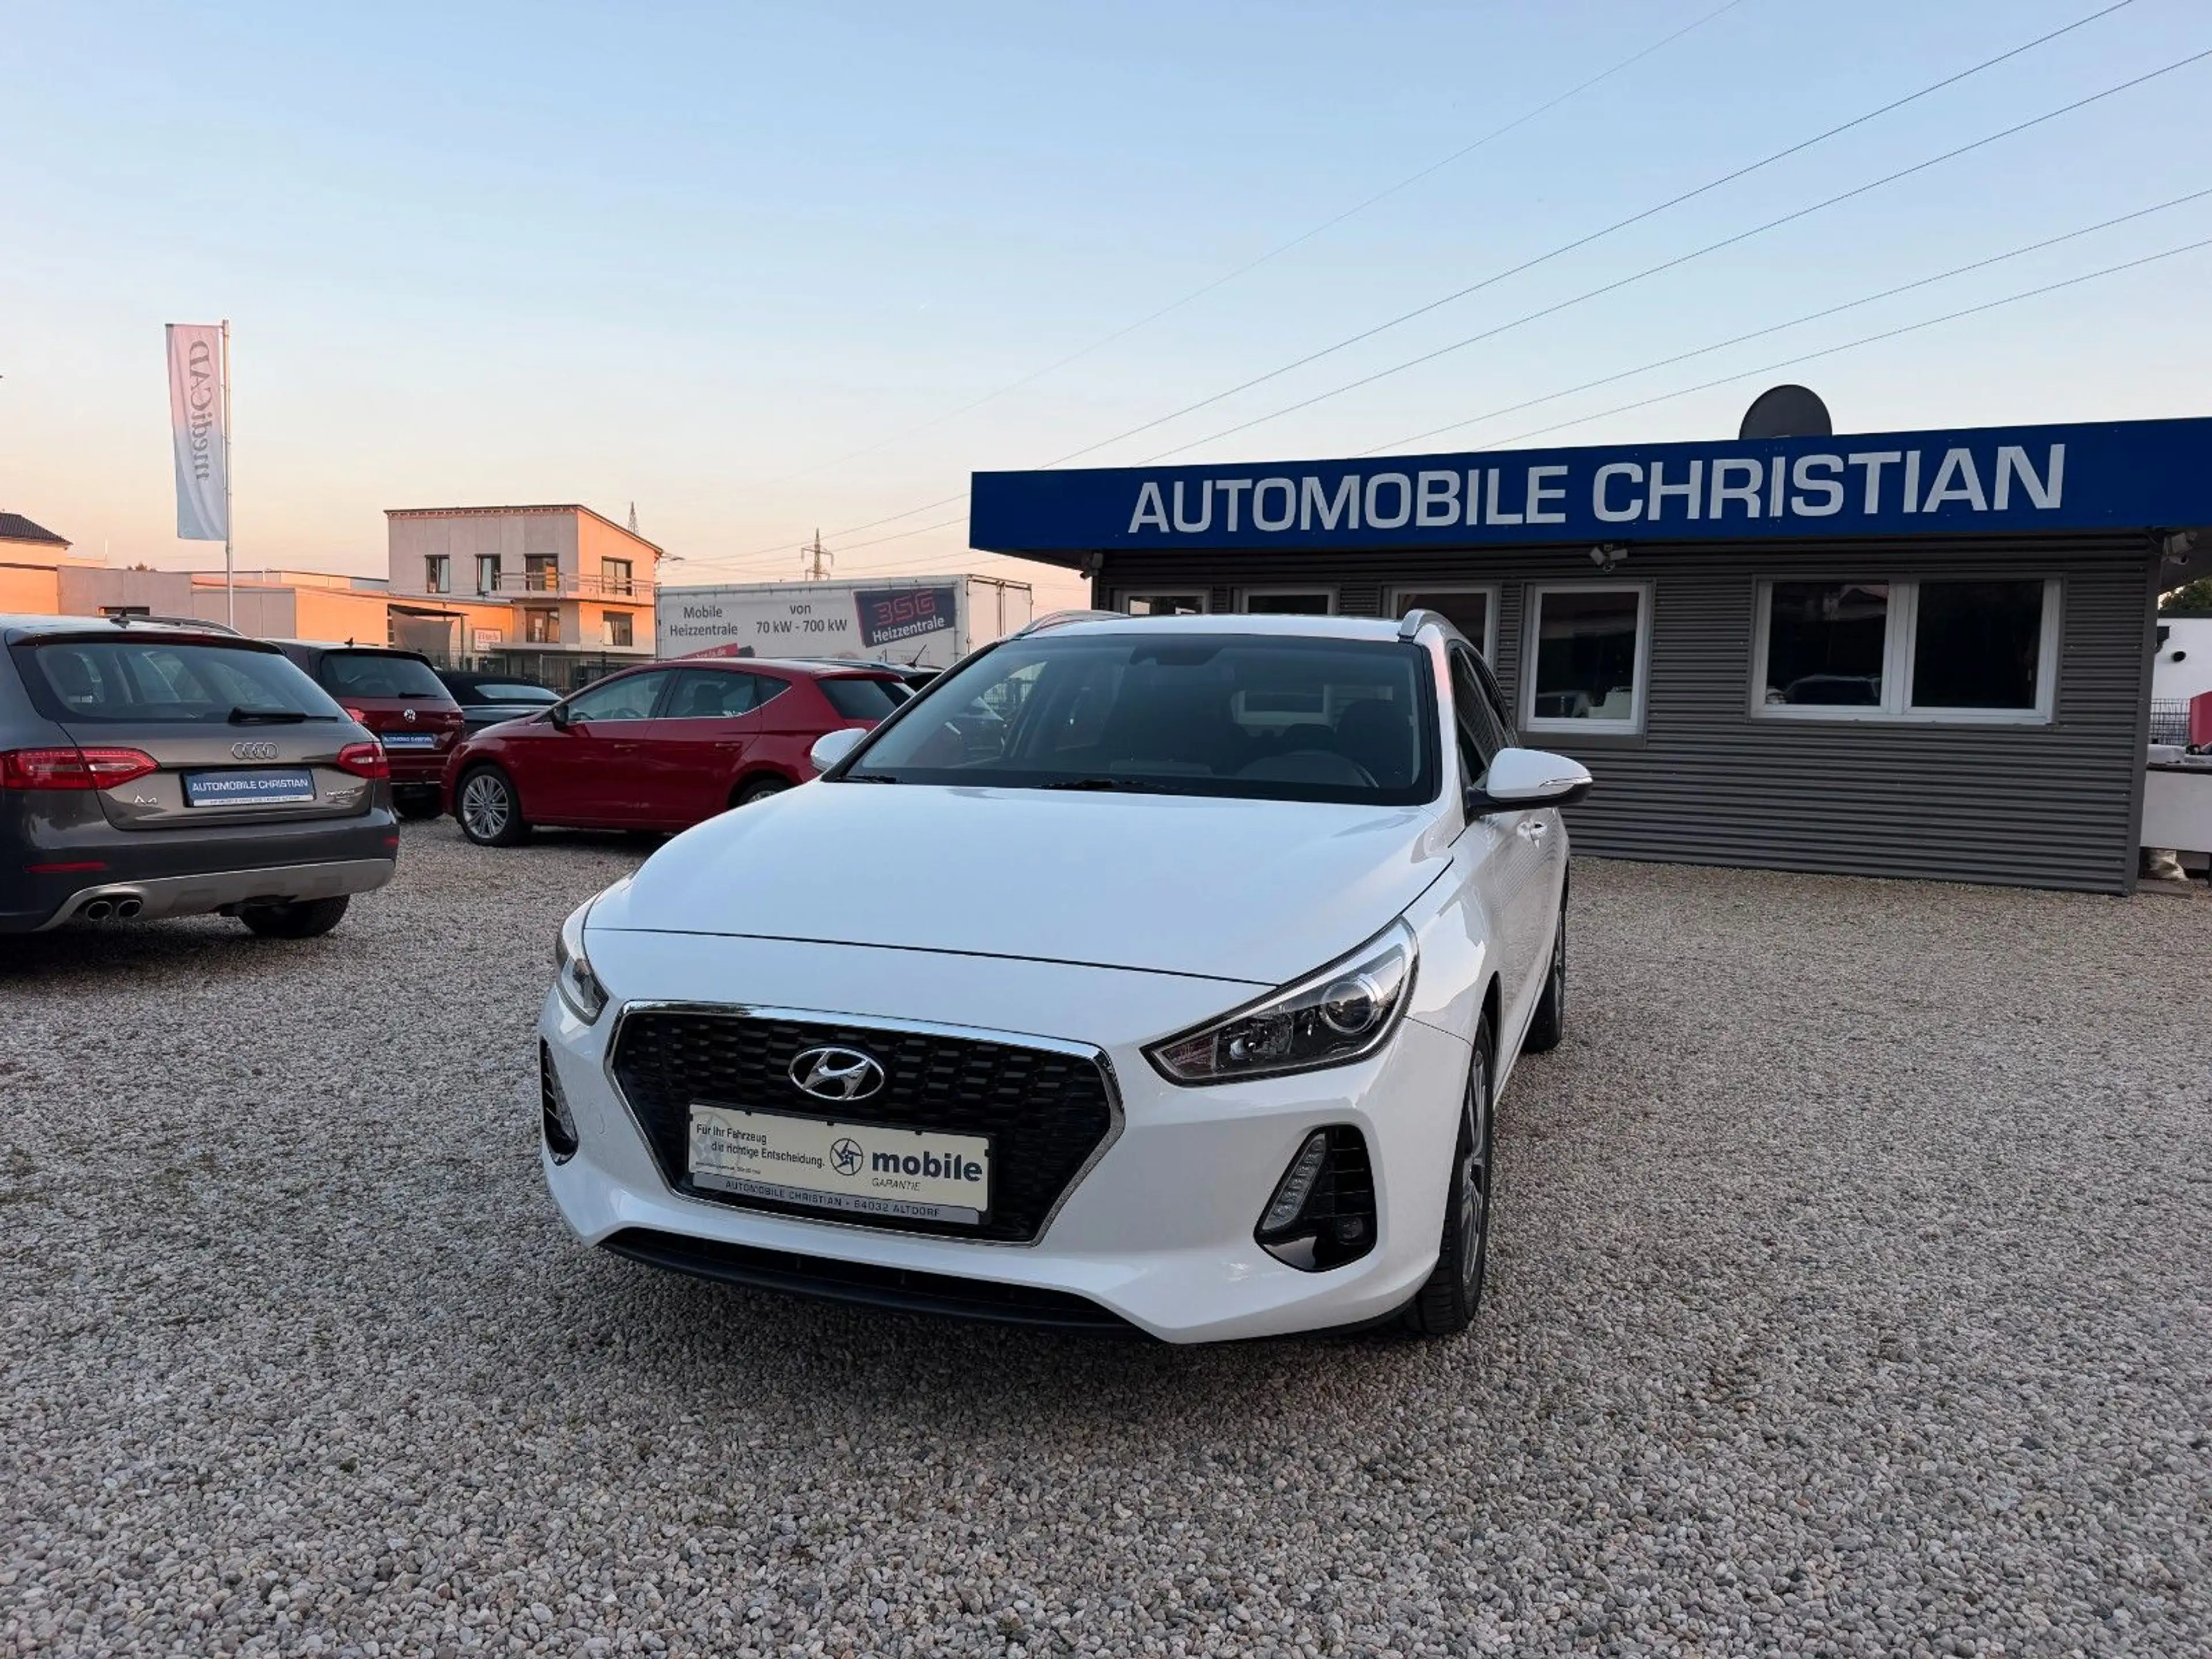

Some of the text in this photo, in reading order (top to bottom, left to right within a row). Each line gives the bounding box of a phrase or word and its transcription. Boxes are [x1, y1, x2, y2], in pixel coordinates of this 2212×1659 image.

[1128, 444, 2066, 533] AUTOMOBILE CHRISTIAN
[684, 606, 722, 619] Mobile
[790, 605, 811, 615] von
[670, 623, 738, 637] Heizzentrale
[756, 622, 770, 633] 70
[774, 621, 792, 632] kW
[803, 620, 824, 632] 700
[828, 619, 847, 631] kW
[872, 615, 945, 643] Heizzentrale
[193, 779, 308, 791] AUTOMOBILE CHRISTIAN
[696, 1123, 767, 1145] Für Ihr Fahrzeug
[726, 1145, 759, 1159] richtige
[762, 1148, 825, 1169] Entscheidung.
[872, 1150, 982, 1181] mobile
[872, 1177, 921, 1191] GARANTIE
[725, 1180, 785, 1198] AUTOMOBILE
[789, 1191, 842, 1206] CHRISTIAN
[893, 1203, 941, 1217] ALTDORF
